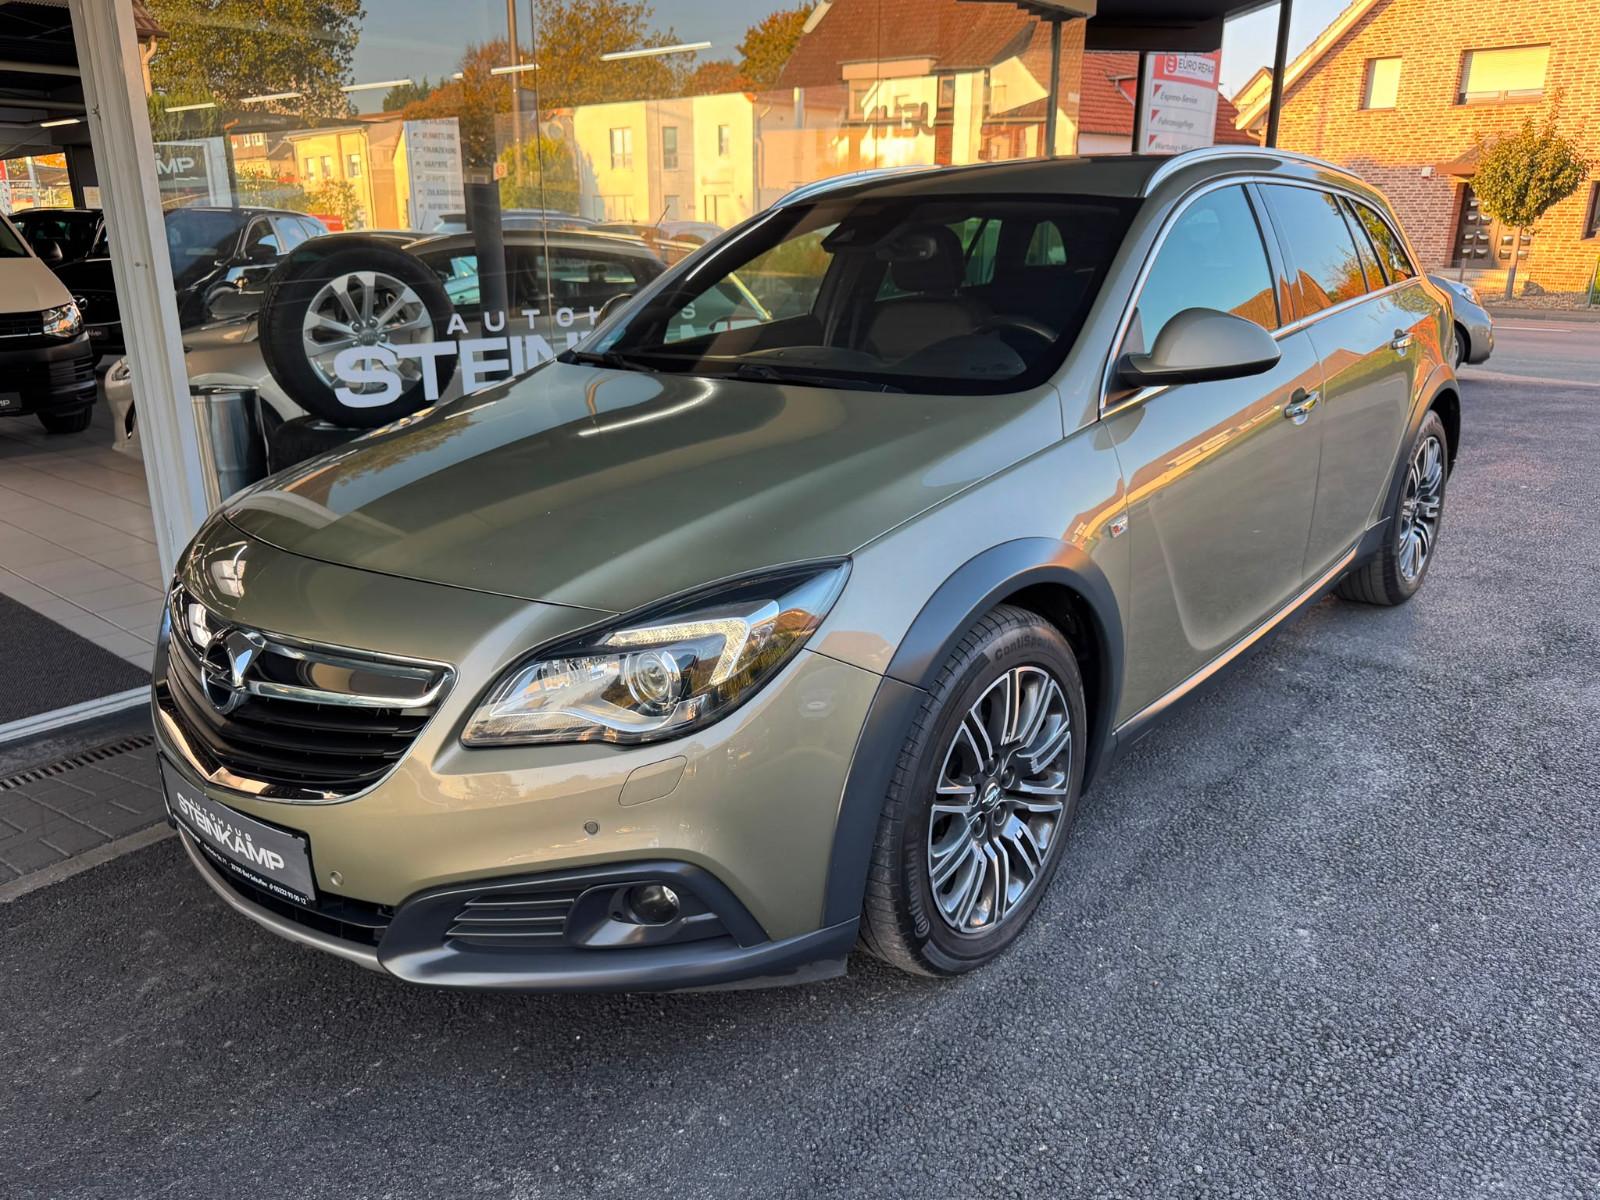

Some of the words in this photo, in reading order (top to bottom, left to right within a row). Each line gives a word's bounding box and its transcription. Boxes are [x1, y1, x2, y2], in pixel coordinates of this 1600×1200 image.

[1178, 57, 1197, 72] EURO
[333, 331, 591, 409] STEIN
[176, 791, 285, 871] STEINKÄMP
